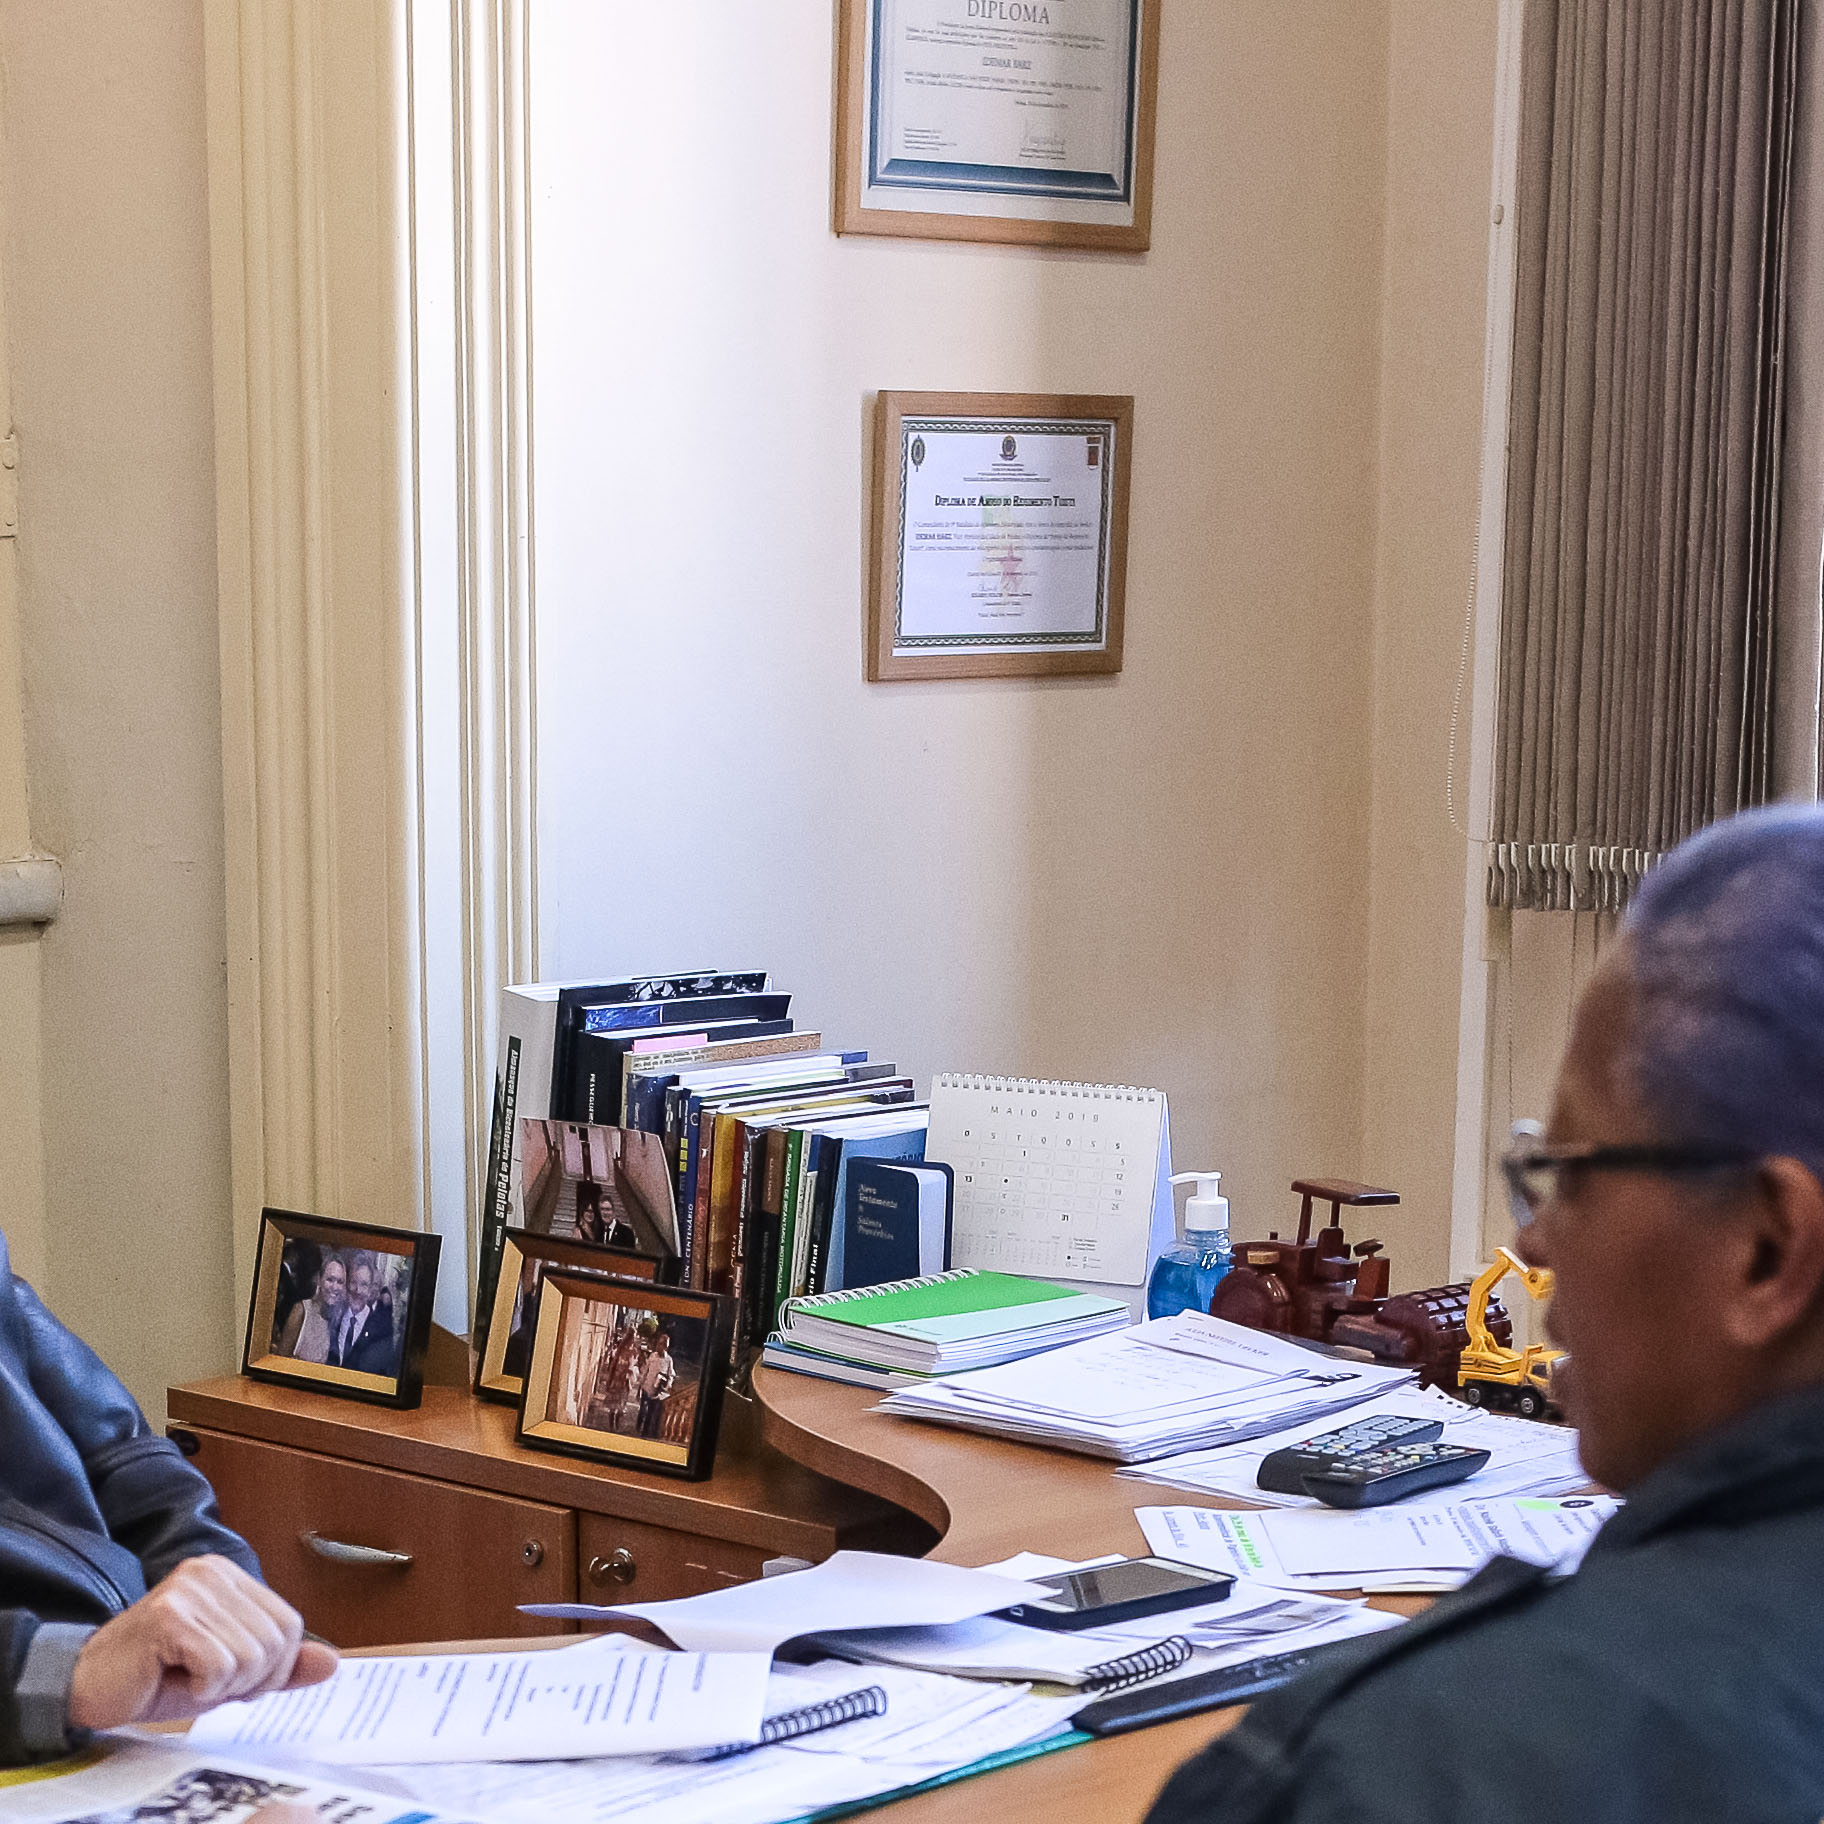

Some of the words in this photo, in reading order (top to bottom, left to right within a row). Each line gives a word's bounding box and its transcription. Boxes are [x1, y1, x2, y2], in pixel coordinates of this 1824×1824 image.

[967, 0, 1050, 24] DIPLOMA
[991, 1106, 1038, 1118] MAIO
[495, 1172, 509, 1219] Pelotas
[685, 1203, 694, 1258] CENTENÁRIO
[809, 1243, 819, 1275] Final
